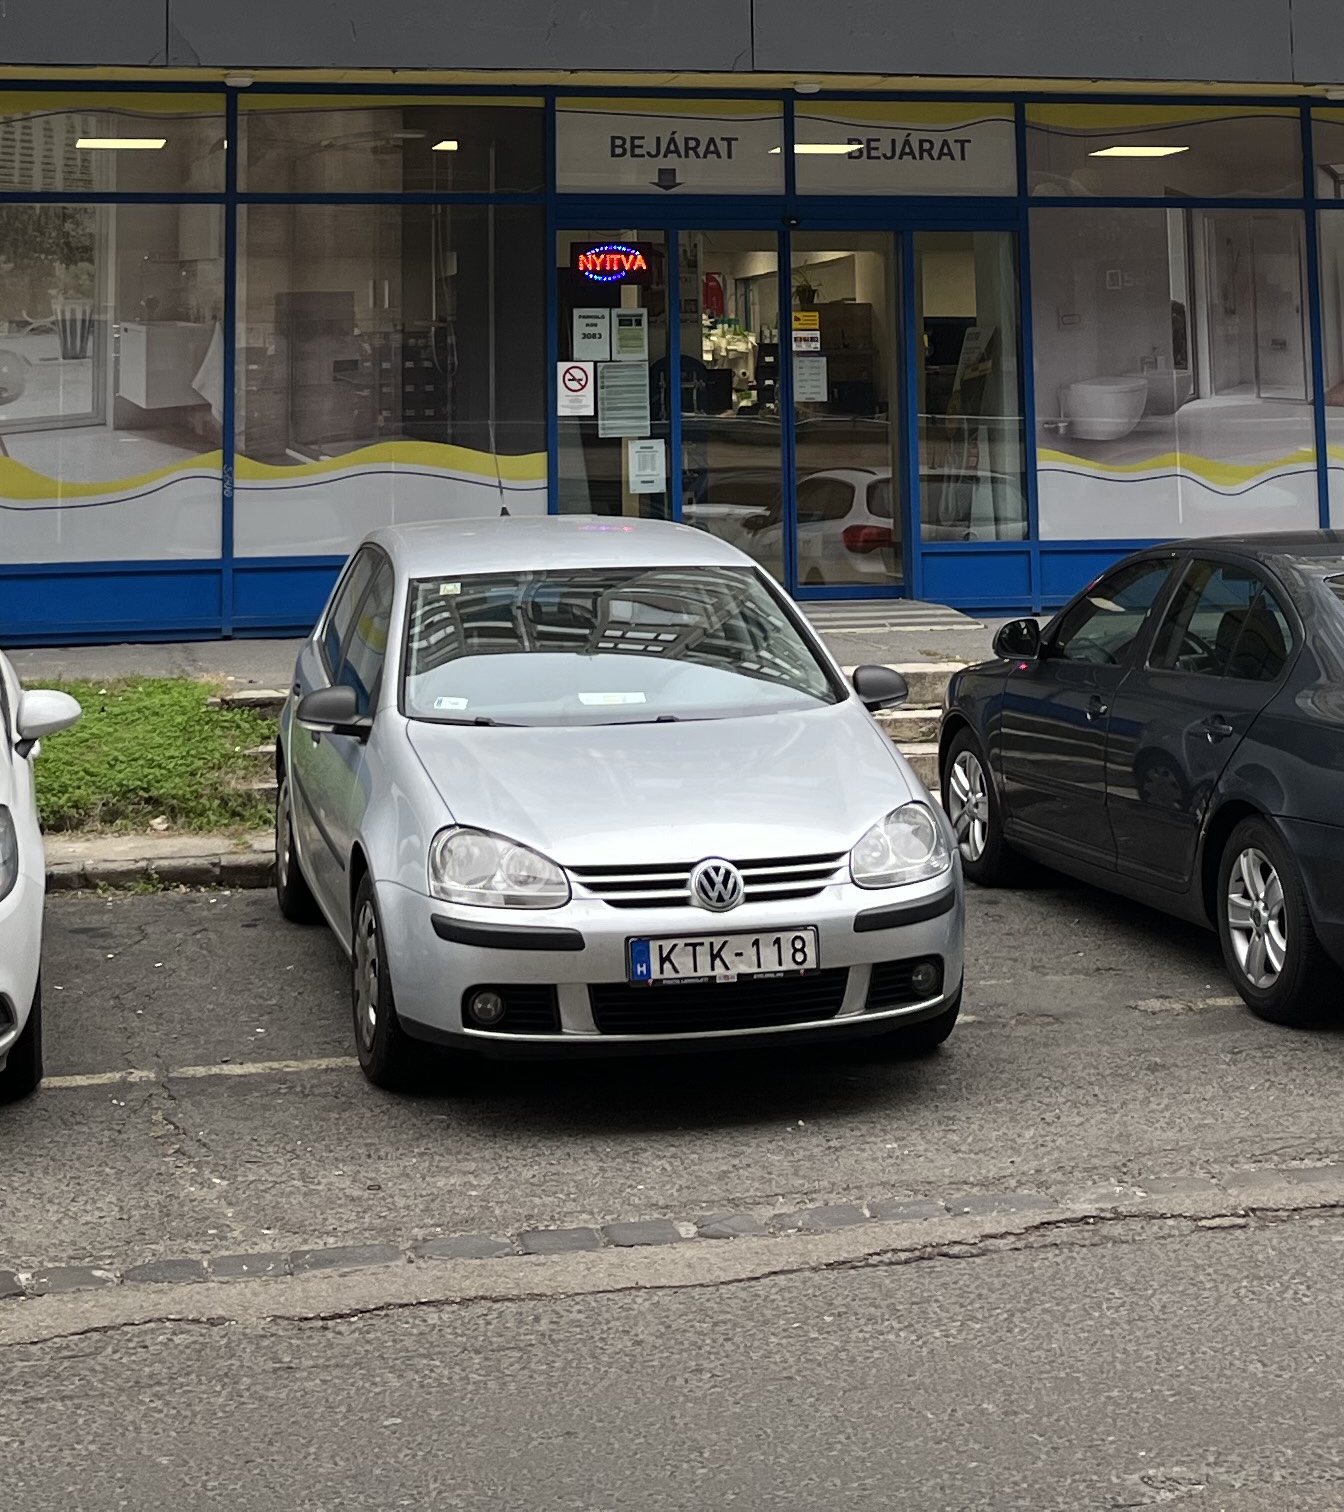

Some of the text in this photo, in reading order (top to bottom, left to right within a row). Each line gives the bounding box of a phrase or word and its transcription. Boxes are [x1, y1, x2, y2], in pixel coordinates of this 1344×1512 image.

[609, 131, 739, 160] BEJÁRAT
[845, 133, 972, 162] BEJÁRAT
[578, 254, 647, 271] NYITVA
[657, 934, 808, 975] KTK-118
[636, 963, 647, 976] H
